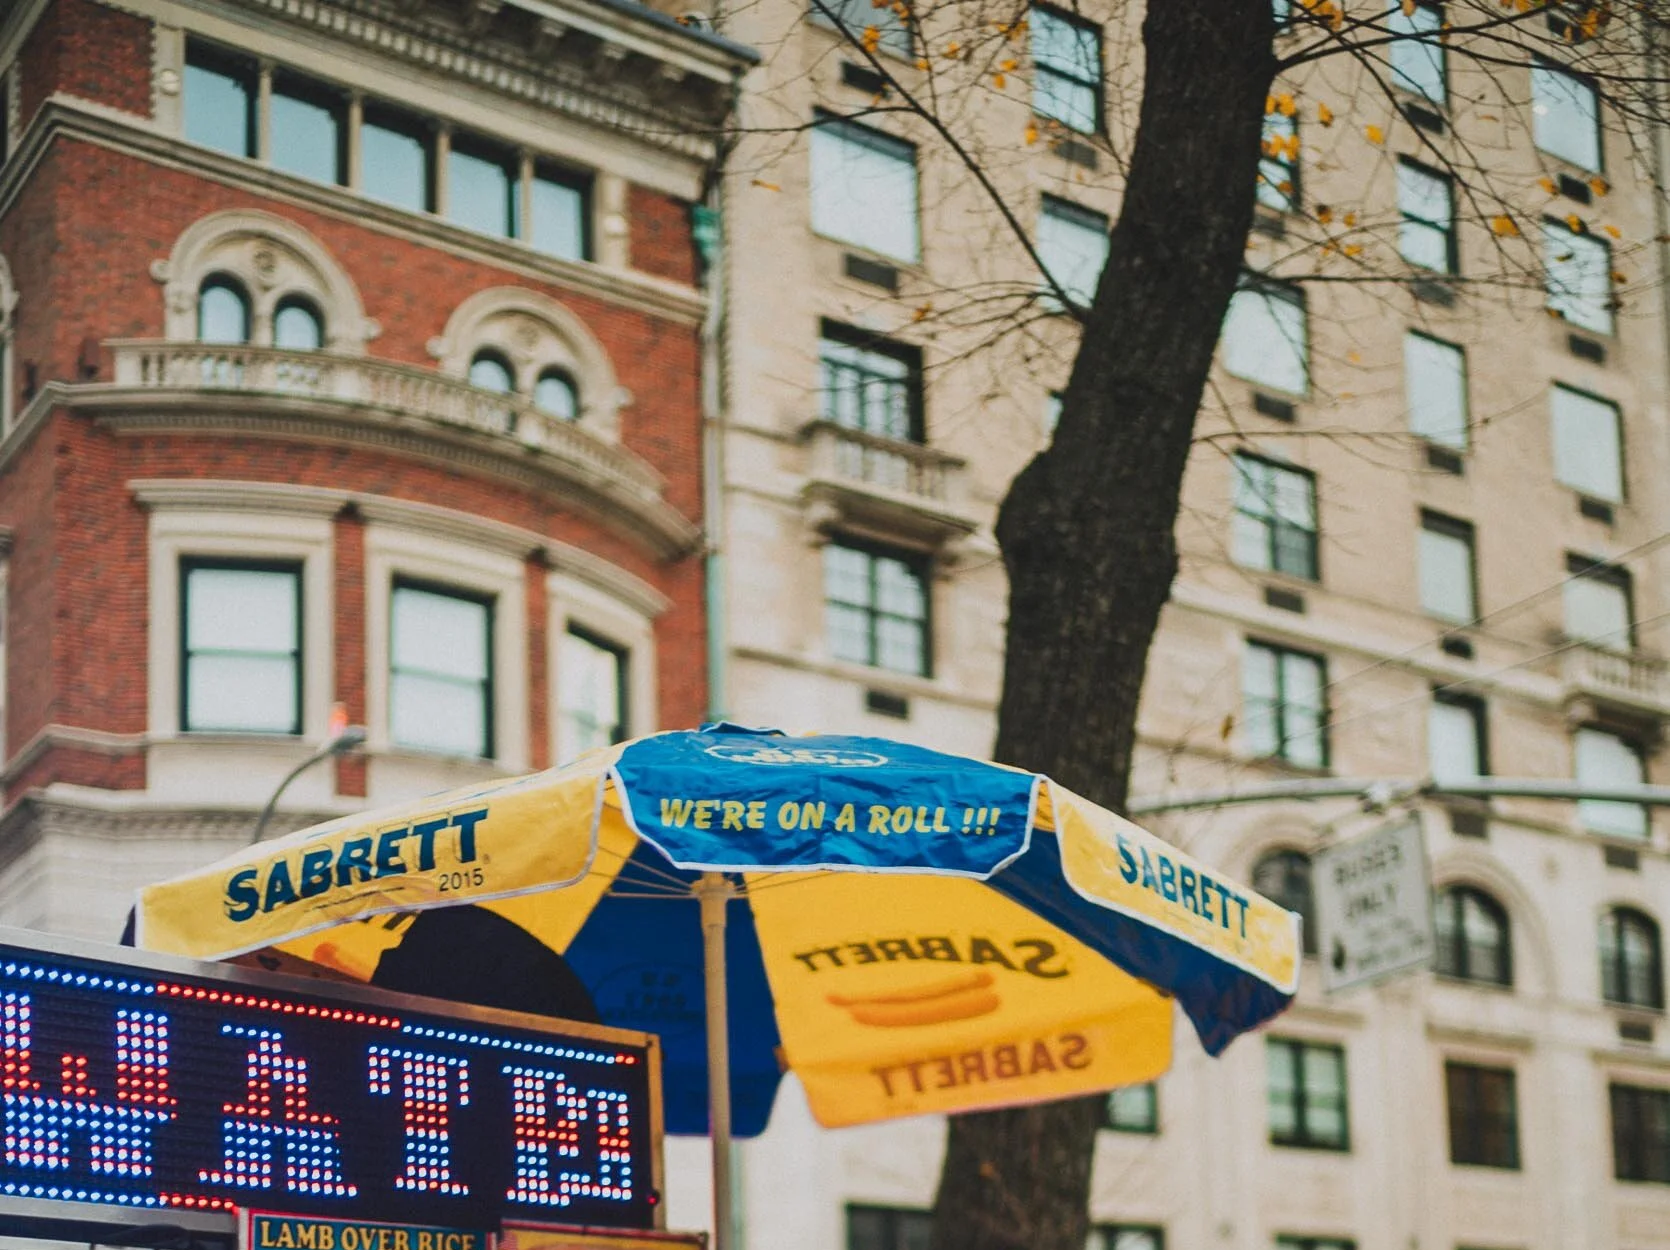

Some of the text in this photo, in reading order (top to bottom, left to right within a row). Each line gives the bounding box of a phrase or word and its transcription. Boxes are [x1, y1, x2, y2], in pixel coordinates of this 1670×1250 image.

[660, 798, 1001, 836] WE'RE ON A ROLL !!!
[224, 808, 489, 922] SABRETT
[439, 868, 484, 892] 2015
[1116, 833, 1249, 939] SABRETT
[260, 1220, 335, 1250] LAMB
